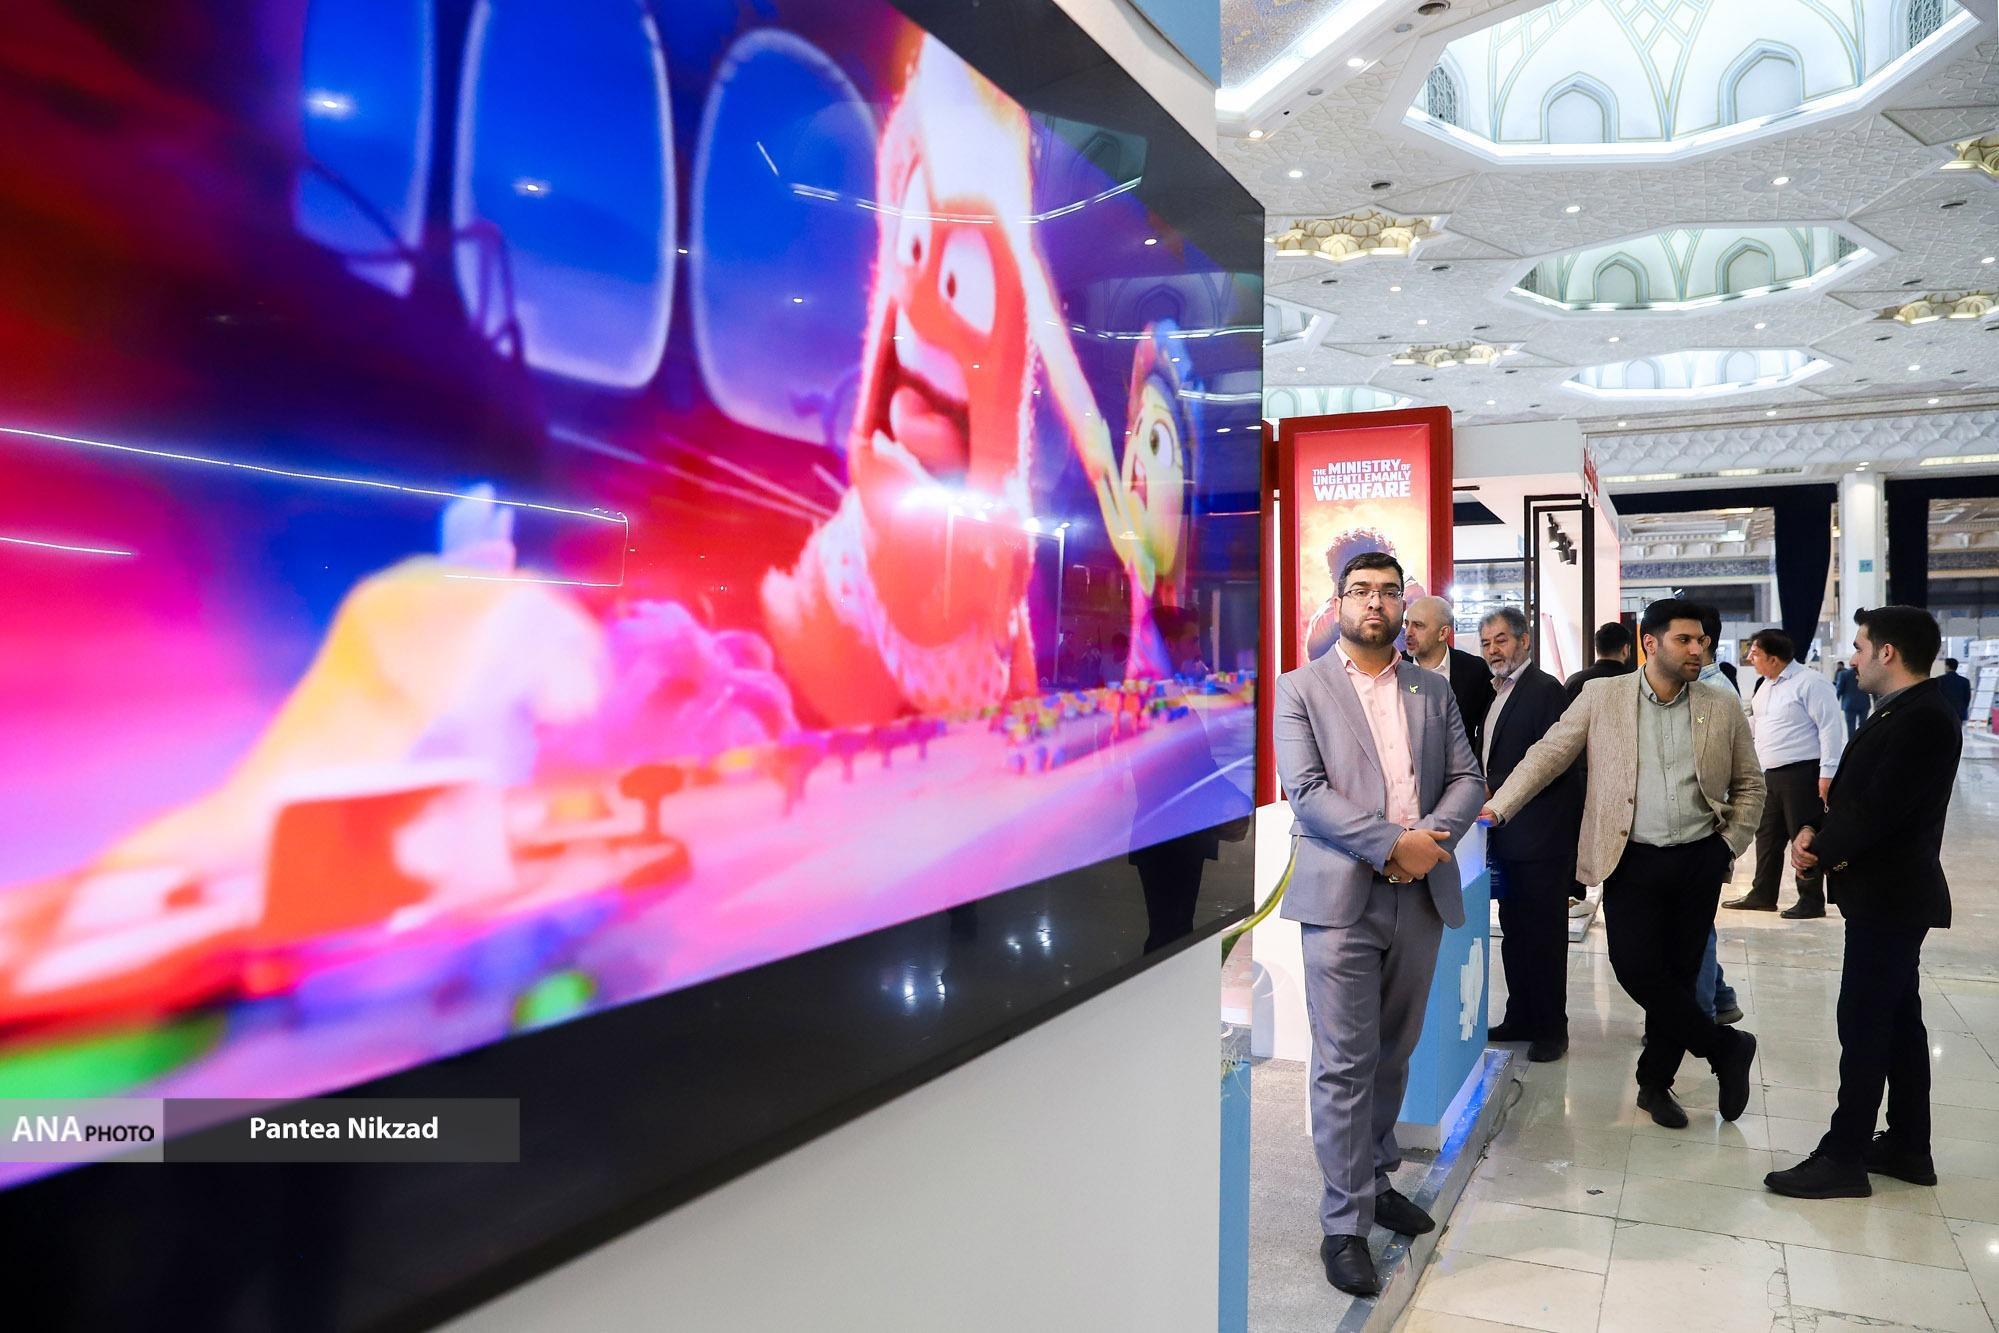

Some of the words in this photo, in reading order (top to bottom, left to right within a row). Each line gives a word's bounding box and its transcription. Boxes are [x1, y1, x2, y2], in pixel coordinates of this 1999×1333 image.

[1328, 459, 1401, 475] MINISTRY
[1312, 470, 1411, 486] UNGENTLEMANLY
[1313, 481, 1411, 502] WARFARE
